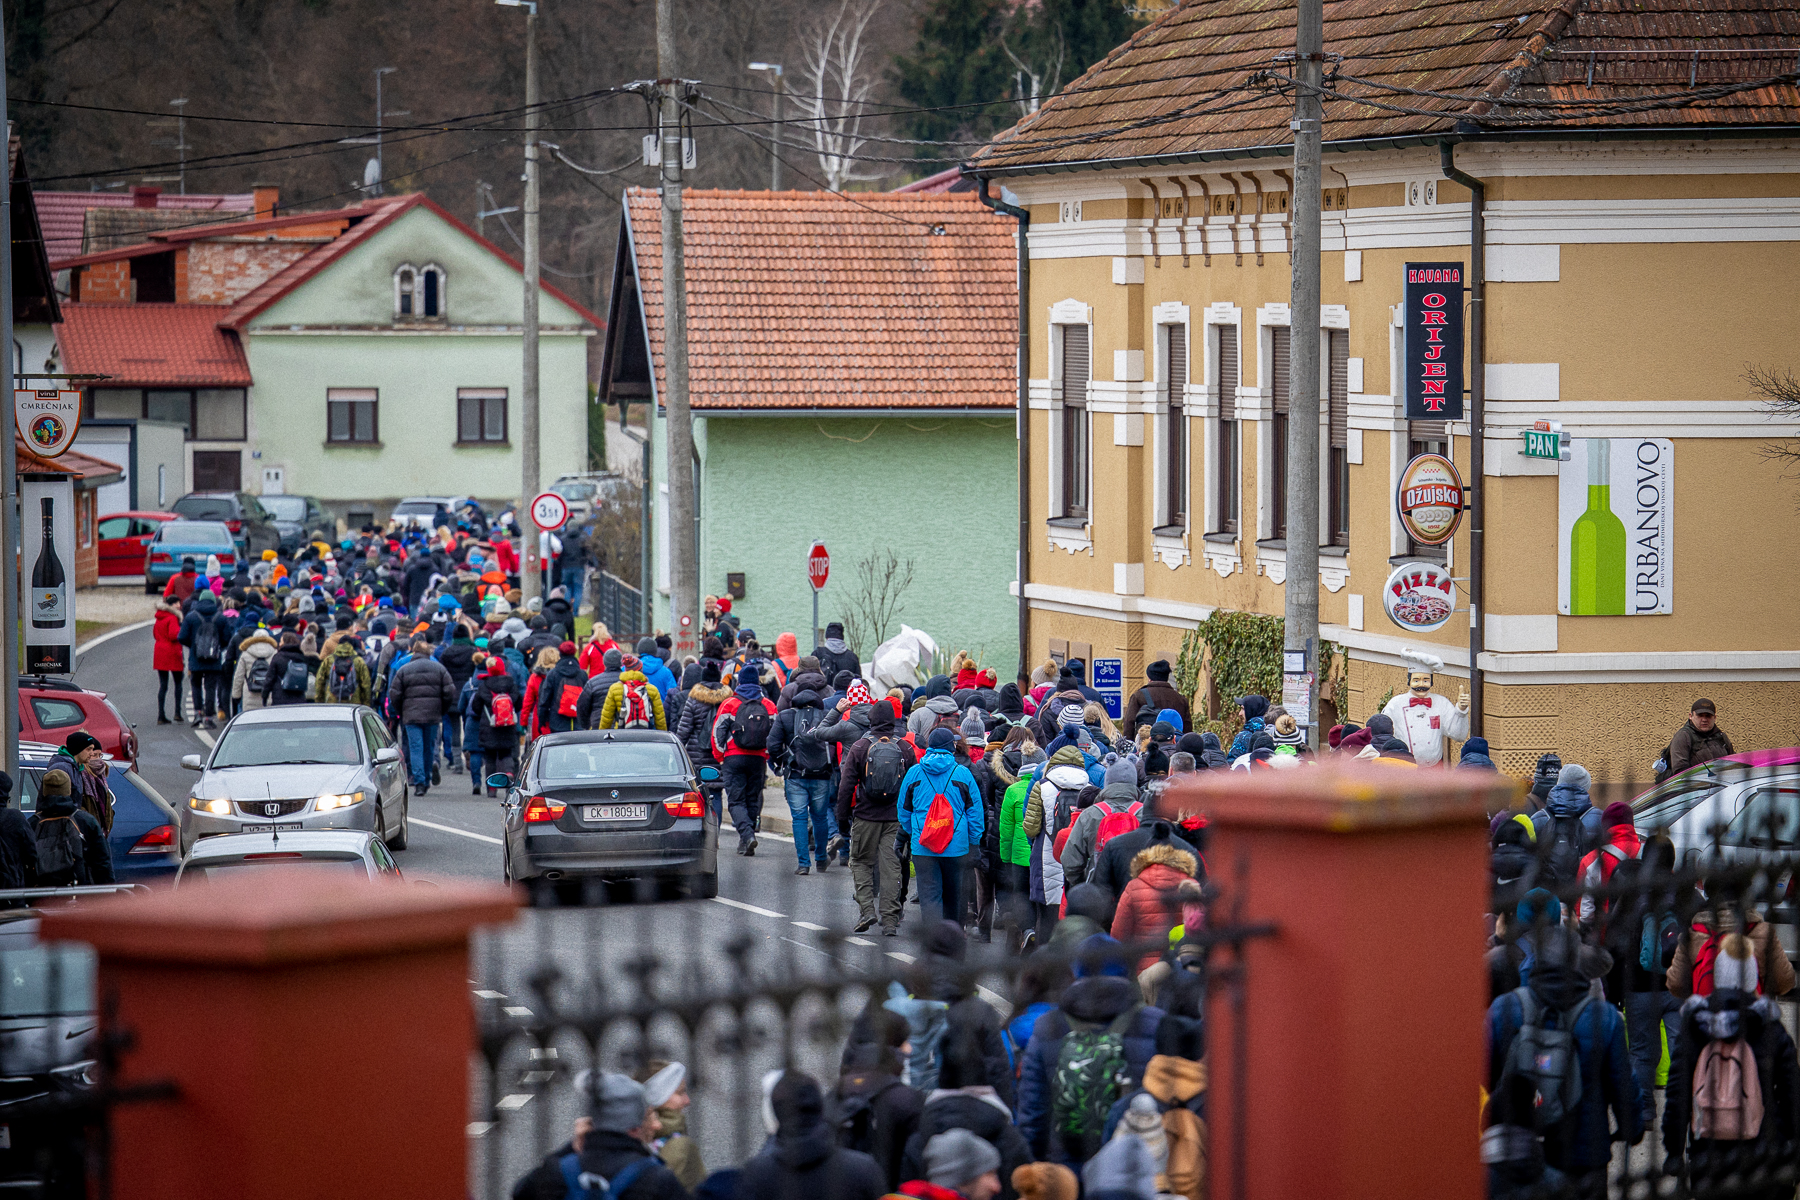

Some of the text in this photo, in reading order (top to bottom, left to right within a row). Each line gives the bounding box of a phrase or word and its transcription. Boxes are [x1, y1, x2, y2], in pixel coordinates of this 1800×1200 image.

[1408, 269, 1460, 283] KAVANA
[1420, 292, 1449, 412] ORIJENT
[21, 402, 74, 411] CMREČNJAK
[1528, 433, 1554, 457] PAN
[1406, 485, 1459, 508] Ožujsko
[1636, 441, 1660, 614] URBANOVO
[810, 557, 829, 577] STOP
[1391, 573, 1452, 598] PIZZA
[591, 808, 602, 818] CK
